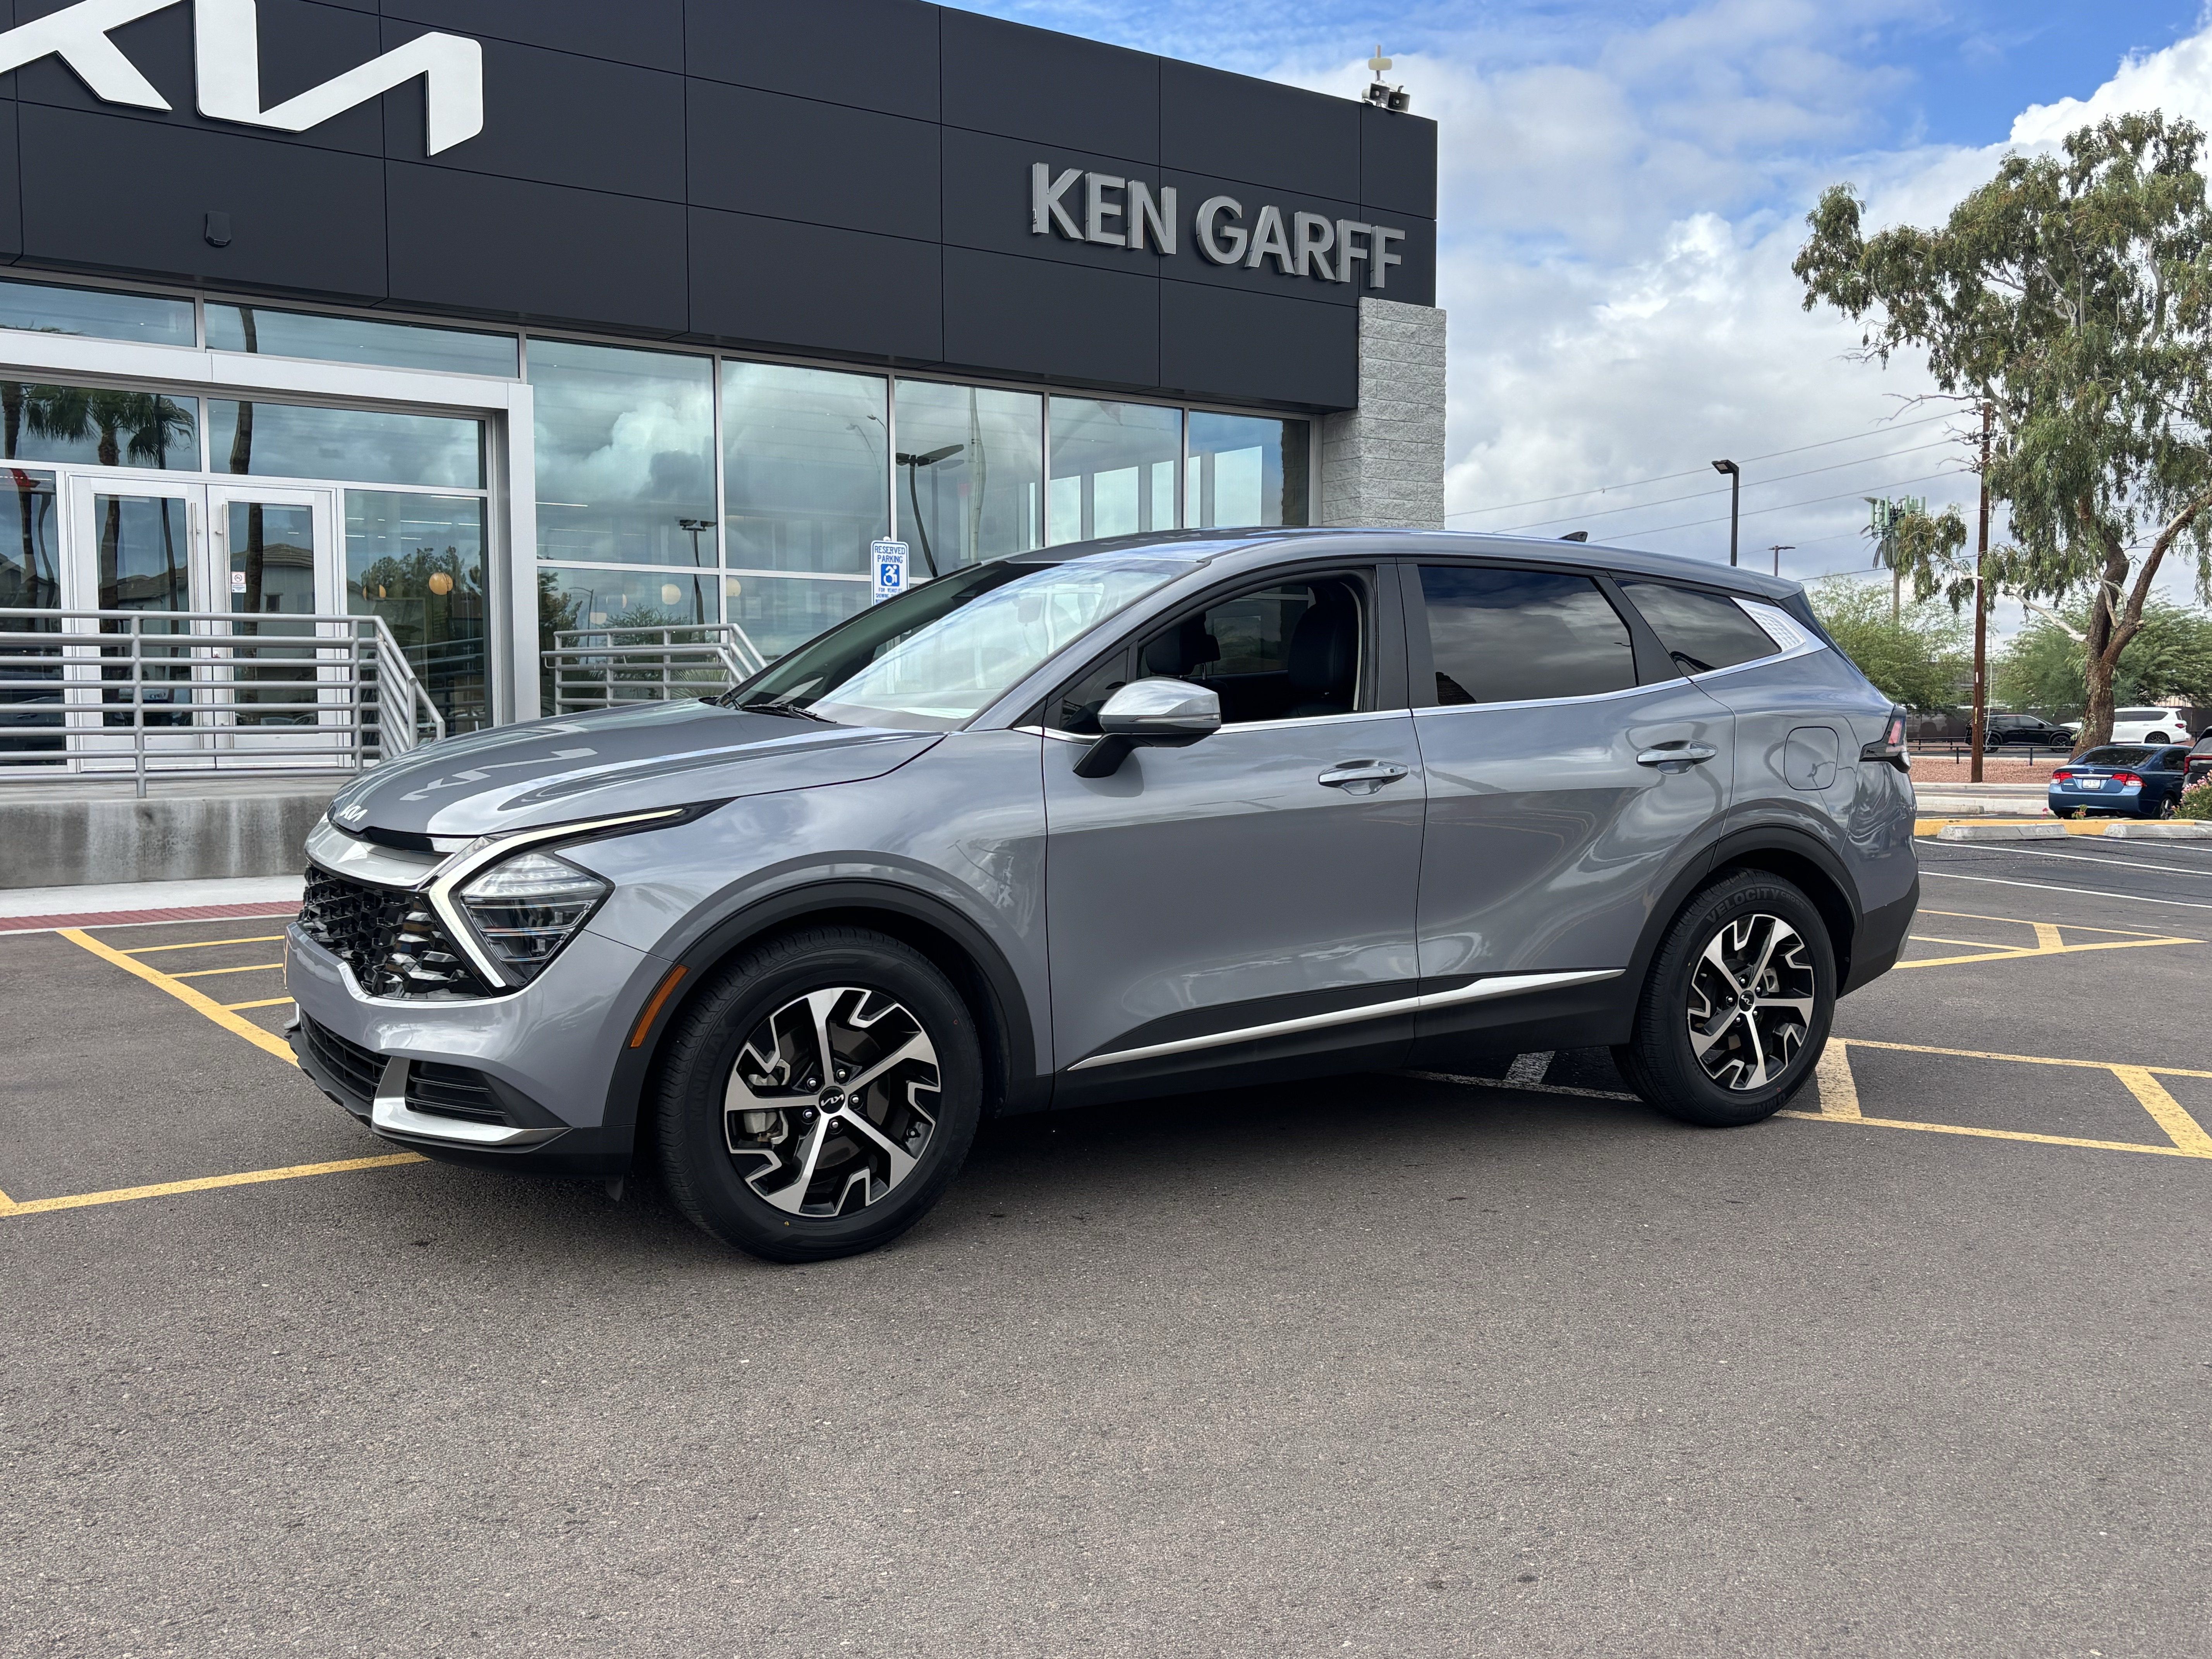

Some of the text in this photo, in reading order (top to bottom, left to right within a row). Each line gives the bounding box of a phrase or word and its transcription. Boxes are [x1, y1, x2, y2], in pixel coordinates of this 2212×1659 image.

[1032, 162, 1405, 289] KEN GARFF
[874, 546, 905, 555] RESERVED
[877, 555, 903, 563] PARKING
[1705, 888, 1806, 923] VELOCITY CROSS
